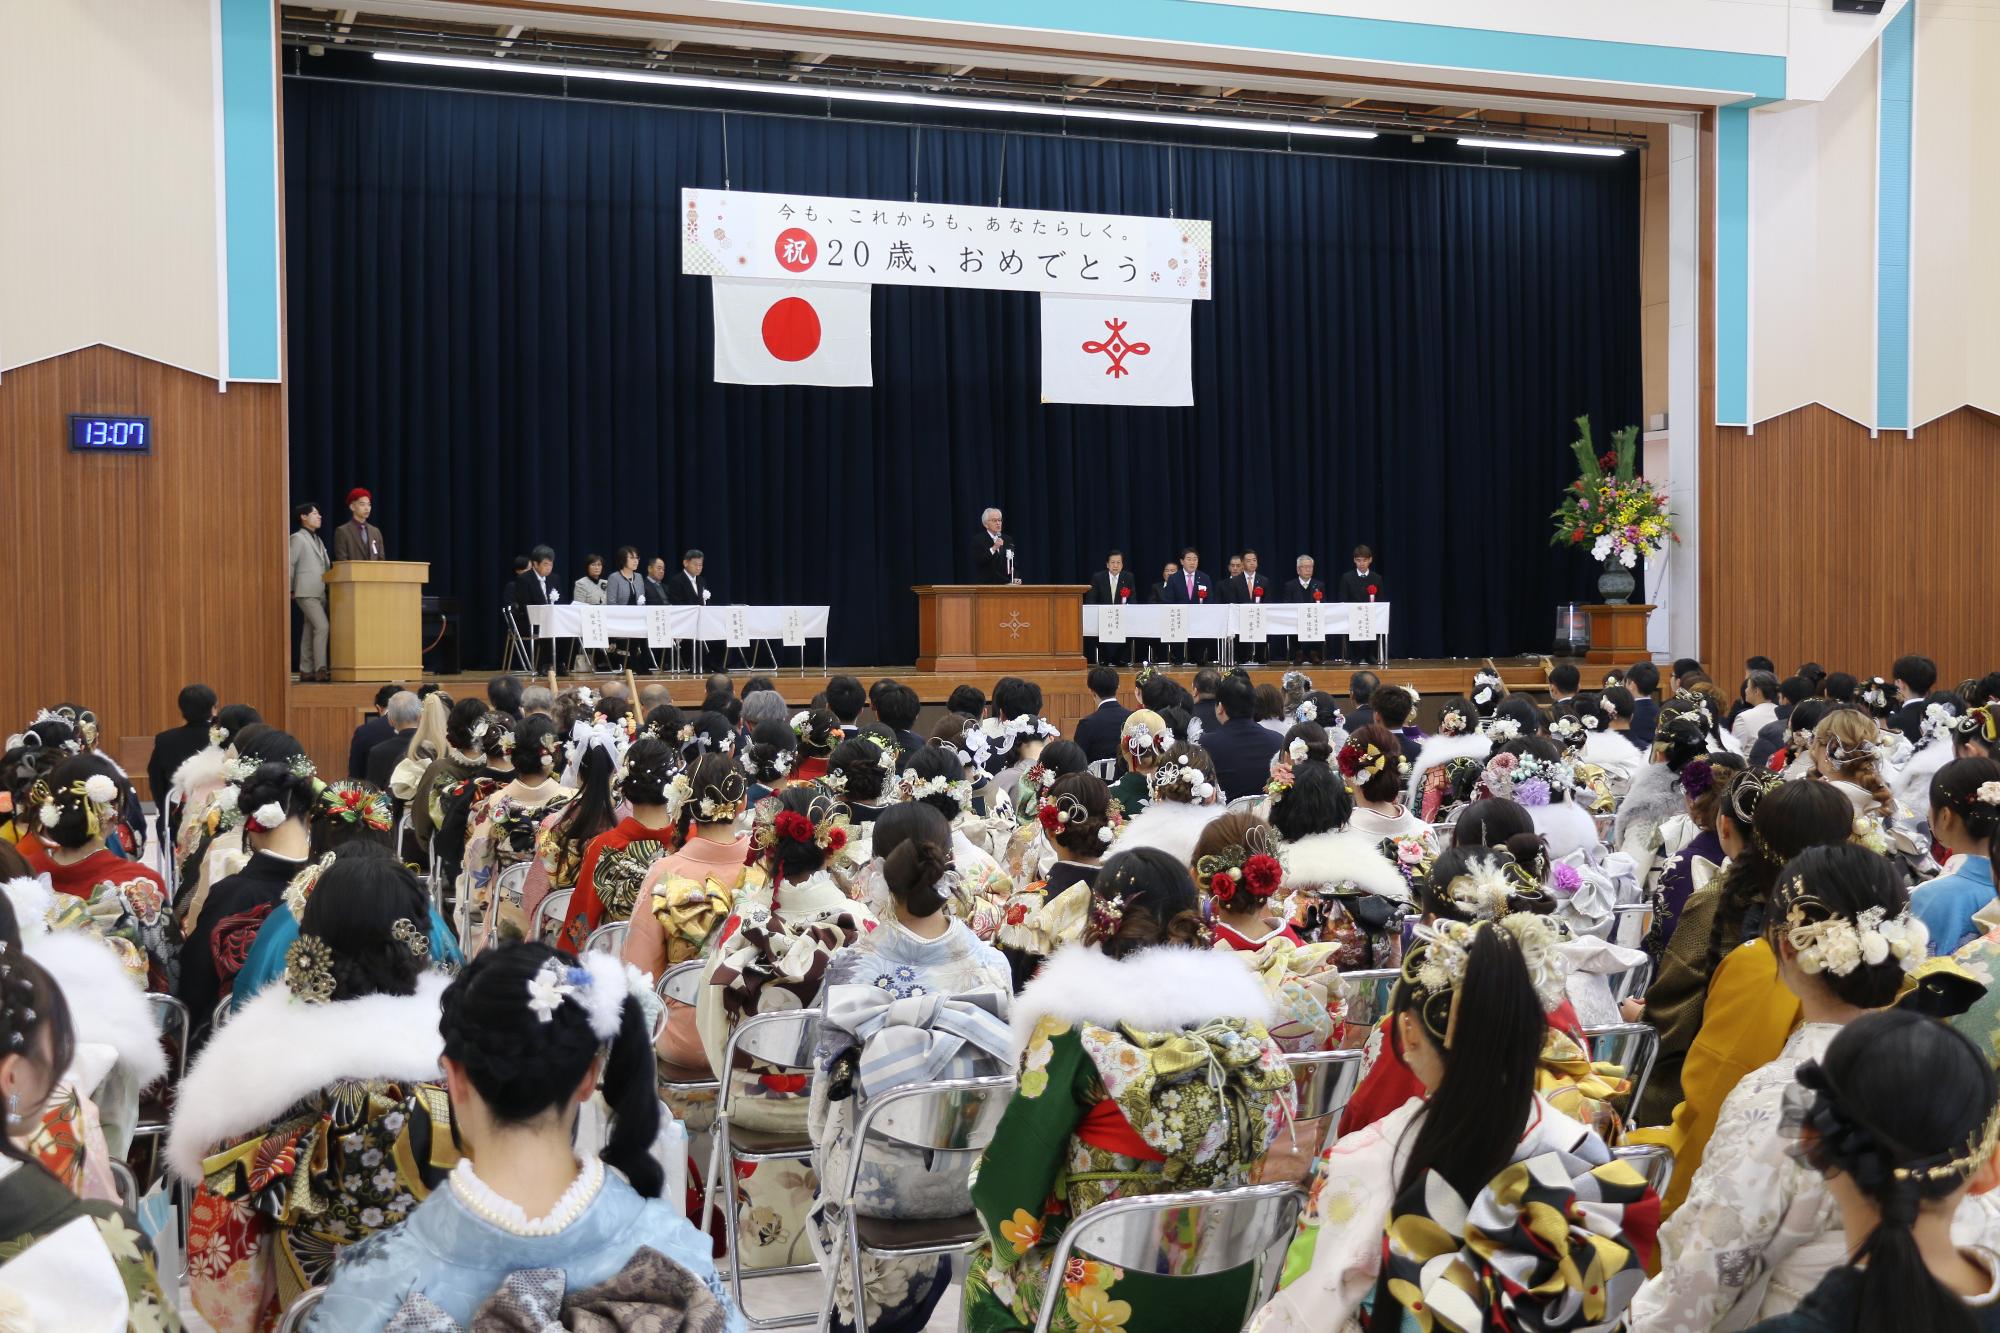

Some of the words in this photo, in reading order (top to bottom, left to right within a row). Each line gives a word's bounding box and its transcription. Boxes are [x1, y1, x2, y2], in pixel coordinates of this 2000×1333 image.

[777, 202, 1129, 242] 今も、これからも、あなたらしく。
[782, 238, 810, 265] 祝
[85, 421, 145, 446] 13:07
